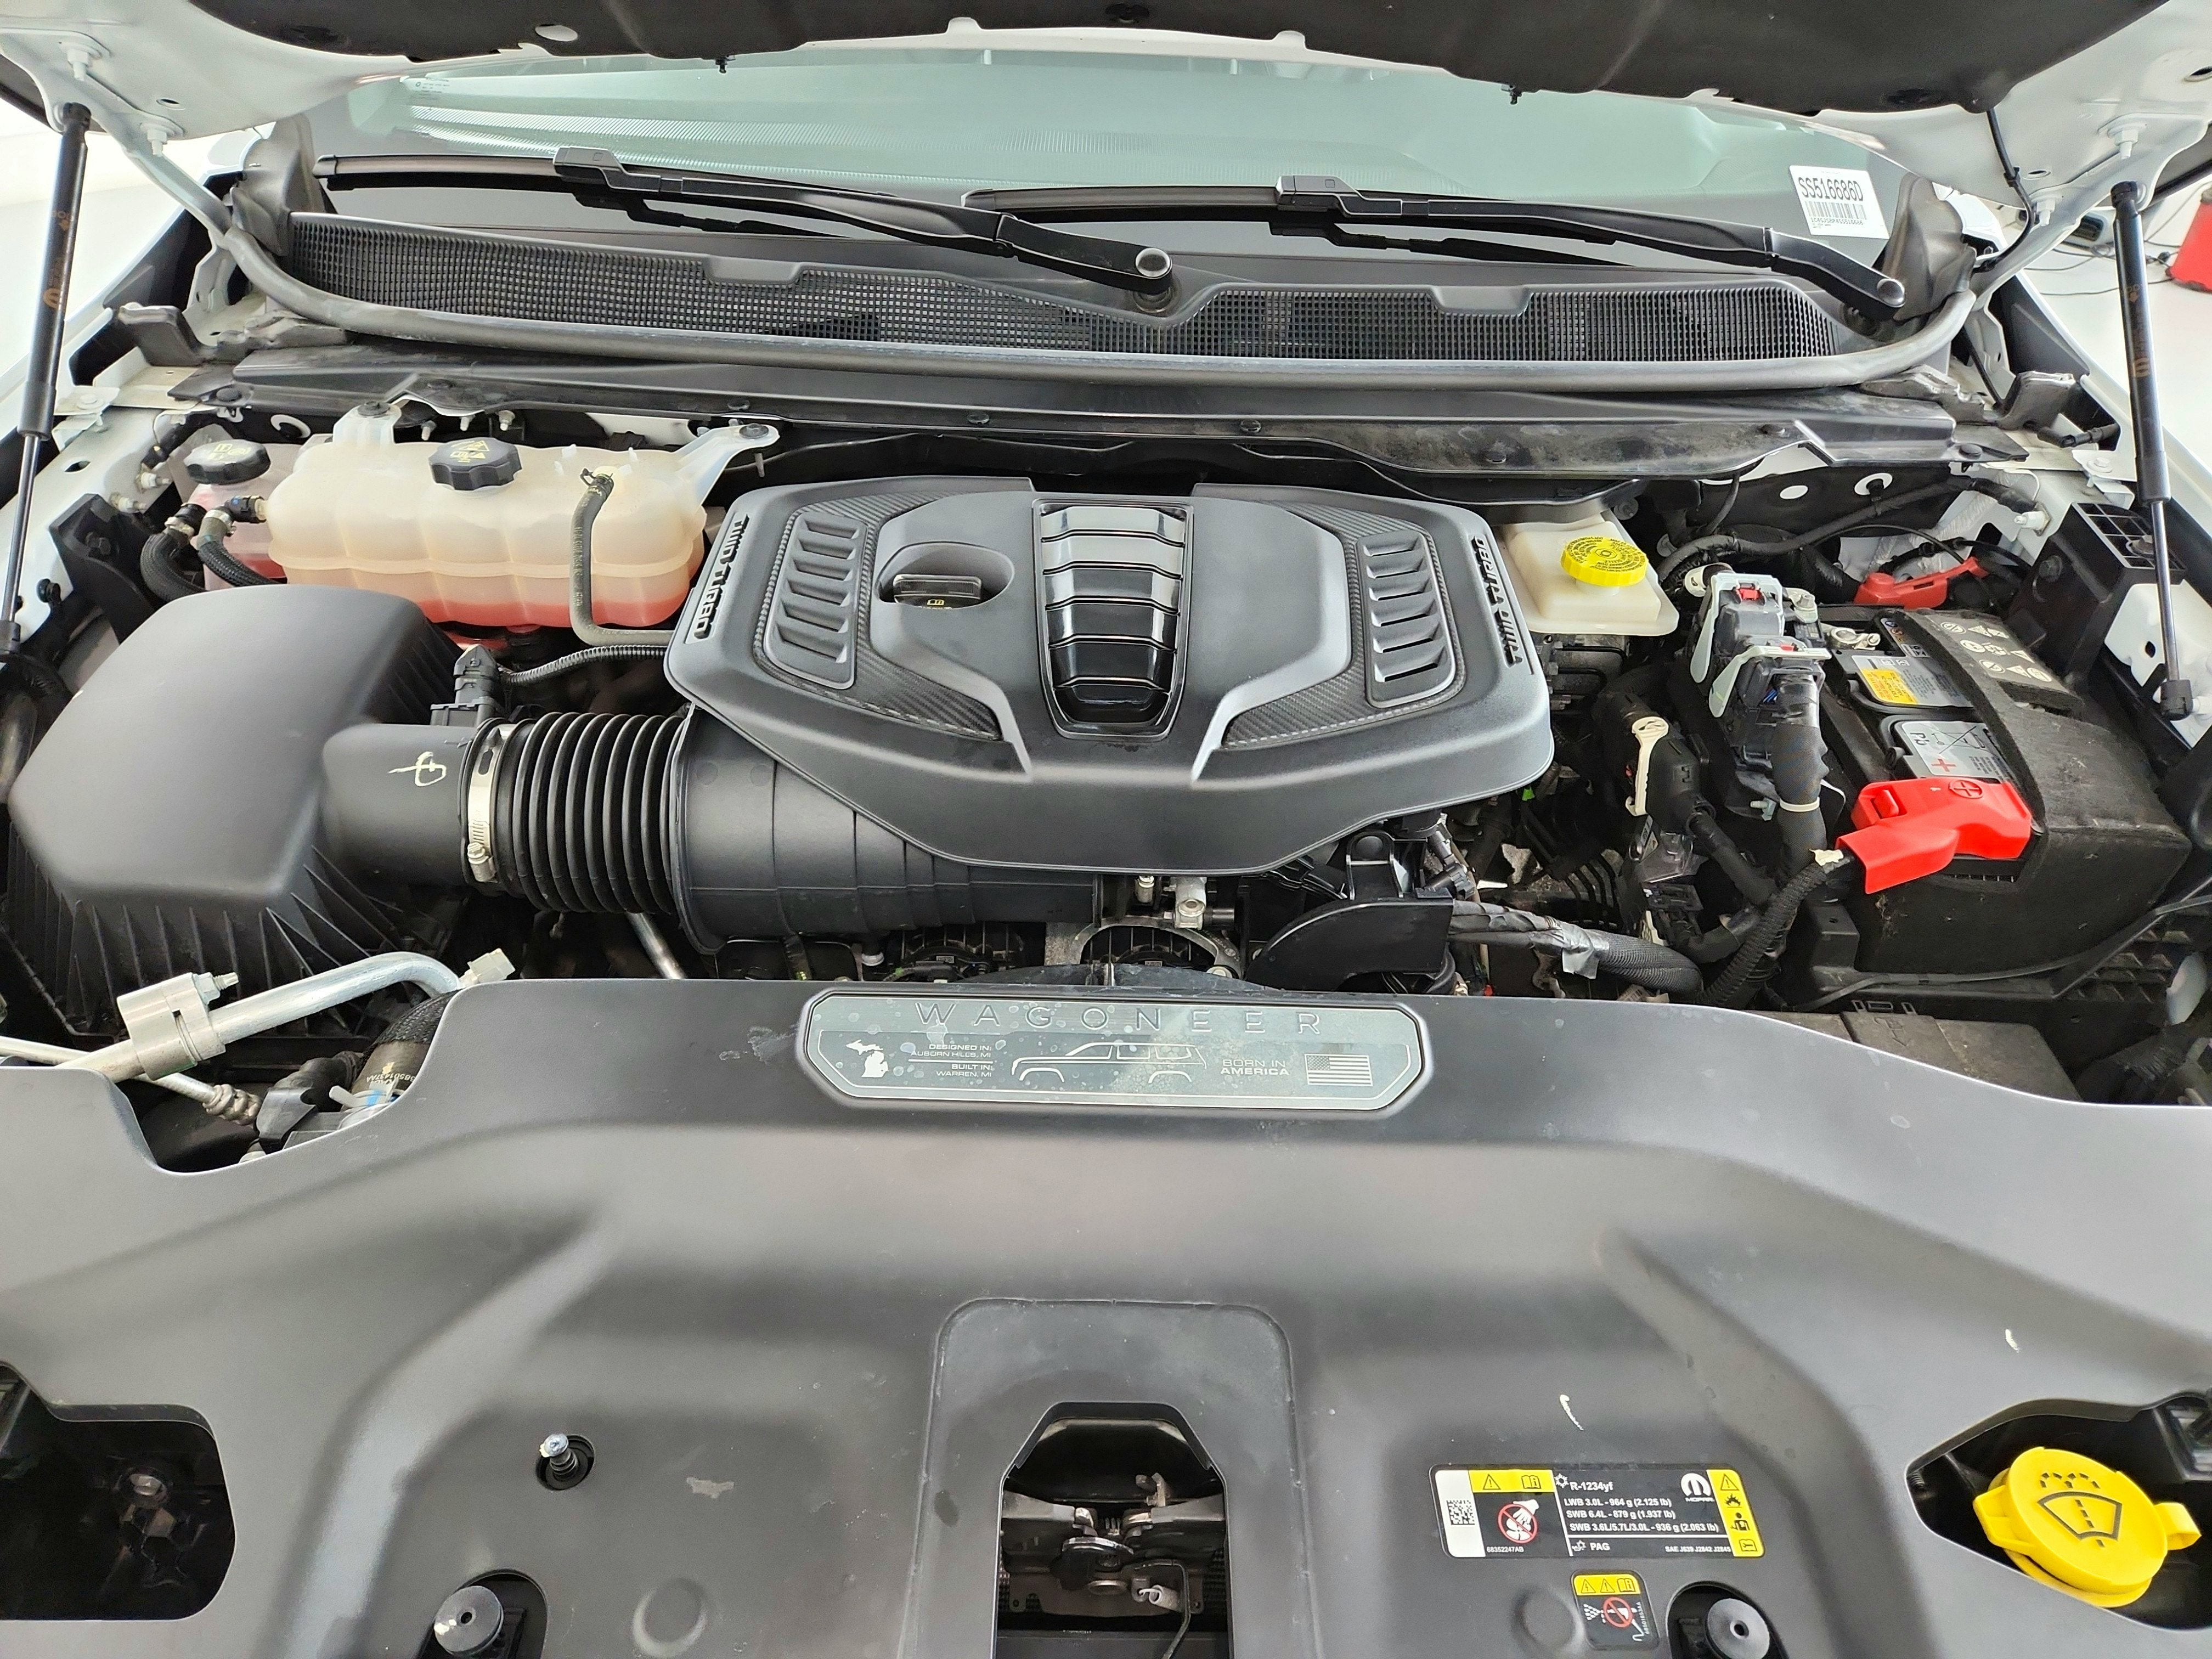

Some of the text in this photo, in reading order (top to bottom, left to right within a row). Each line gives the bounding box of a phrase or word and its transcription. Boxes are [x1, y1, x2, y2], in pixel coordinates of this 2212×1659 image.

[1798, 177, 1863, 201] SS516686D
[1471, 536, 1504, 606] TURBO
[693, 562, 731, 639] TURBO
[1910, 732, 1930, 746] Pb
[915, 1001, 1321, 1035] WAGONEER
[1570, 1482, 1613, 1492] R-1234yf
[1564, 1498, 1584, 1506] LWB
[1585, 1498, 1604, 1506] 3.0L
[1609, 1498, 1625, 1506] 964
[1634, 1498, 1659, 1507] (2.125
[1660, 1498, 1672, 1508] lb)
[1638, 1510, 1662, 1519] (1.937
[1663, 1510, 1676, 1520] lb)
[1592, 1523, 1650, 1532] 3.6L/5.7L/3.0L
[1655, 1523, 1672, 1532] 936
[1680, 1523, 1706, 1532] (2.063
[1707, 1523, 1719, 1532] lb)
